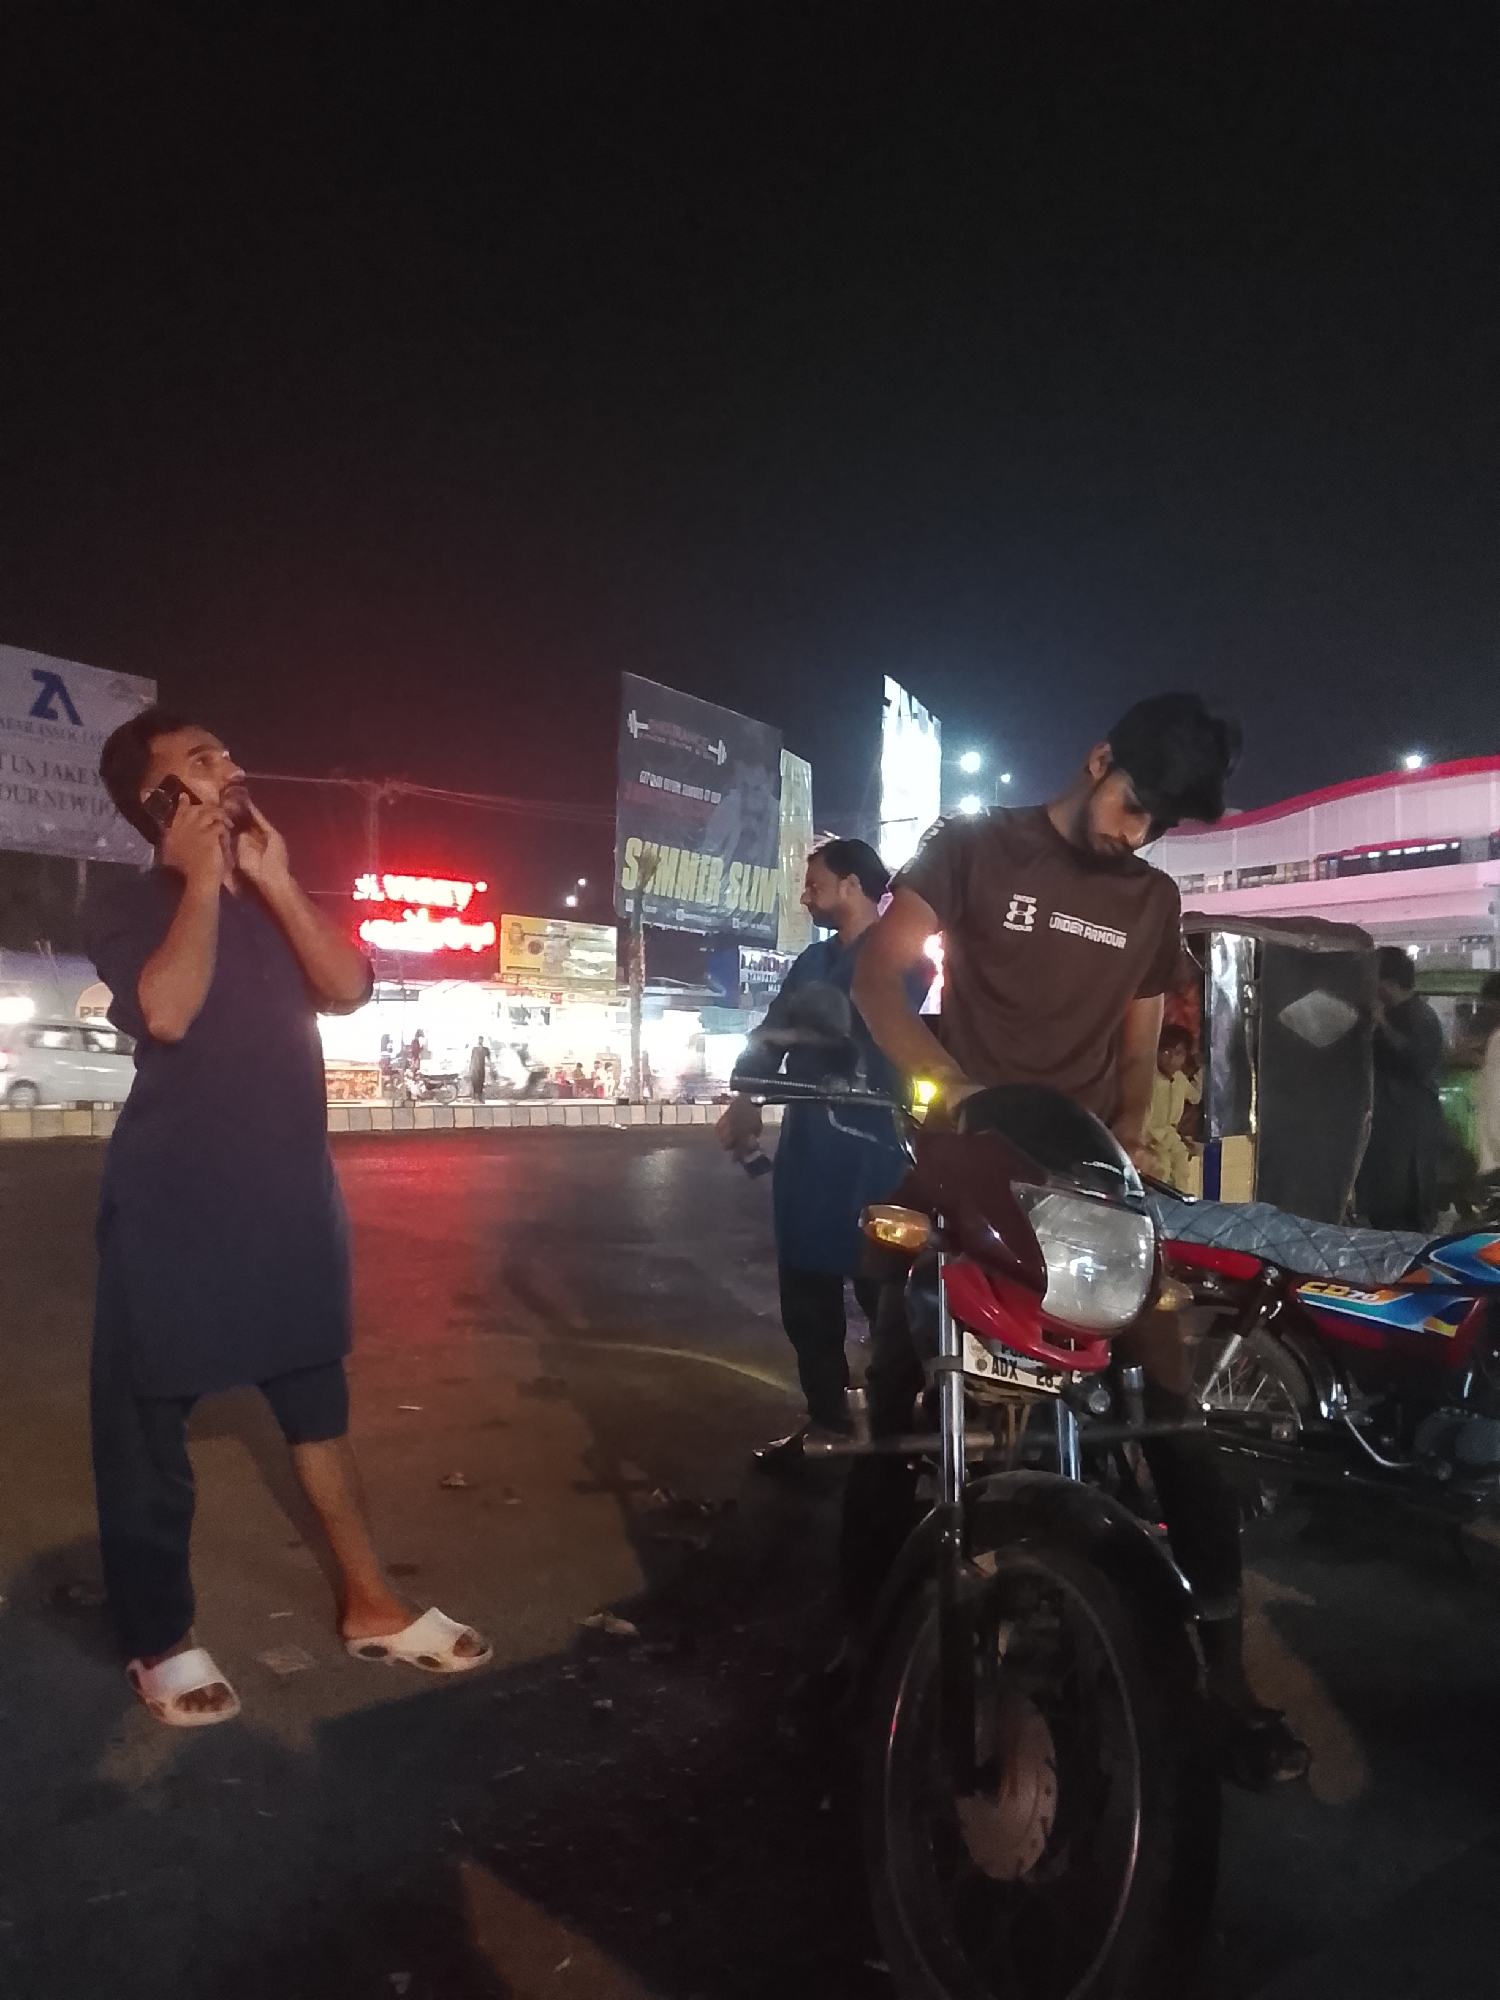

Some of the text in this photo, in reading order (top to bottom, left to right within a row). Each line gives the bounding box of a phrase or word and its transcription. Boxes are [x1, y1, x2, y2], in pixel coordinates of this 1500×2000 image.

[621, 836, 779, 914] SUMMER SLIM
[1049, 916, 1127, 949] UNDER ARMOUR
[991, 1355, 1019, 1381] ADX
